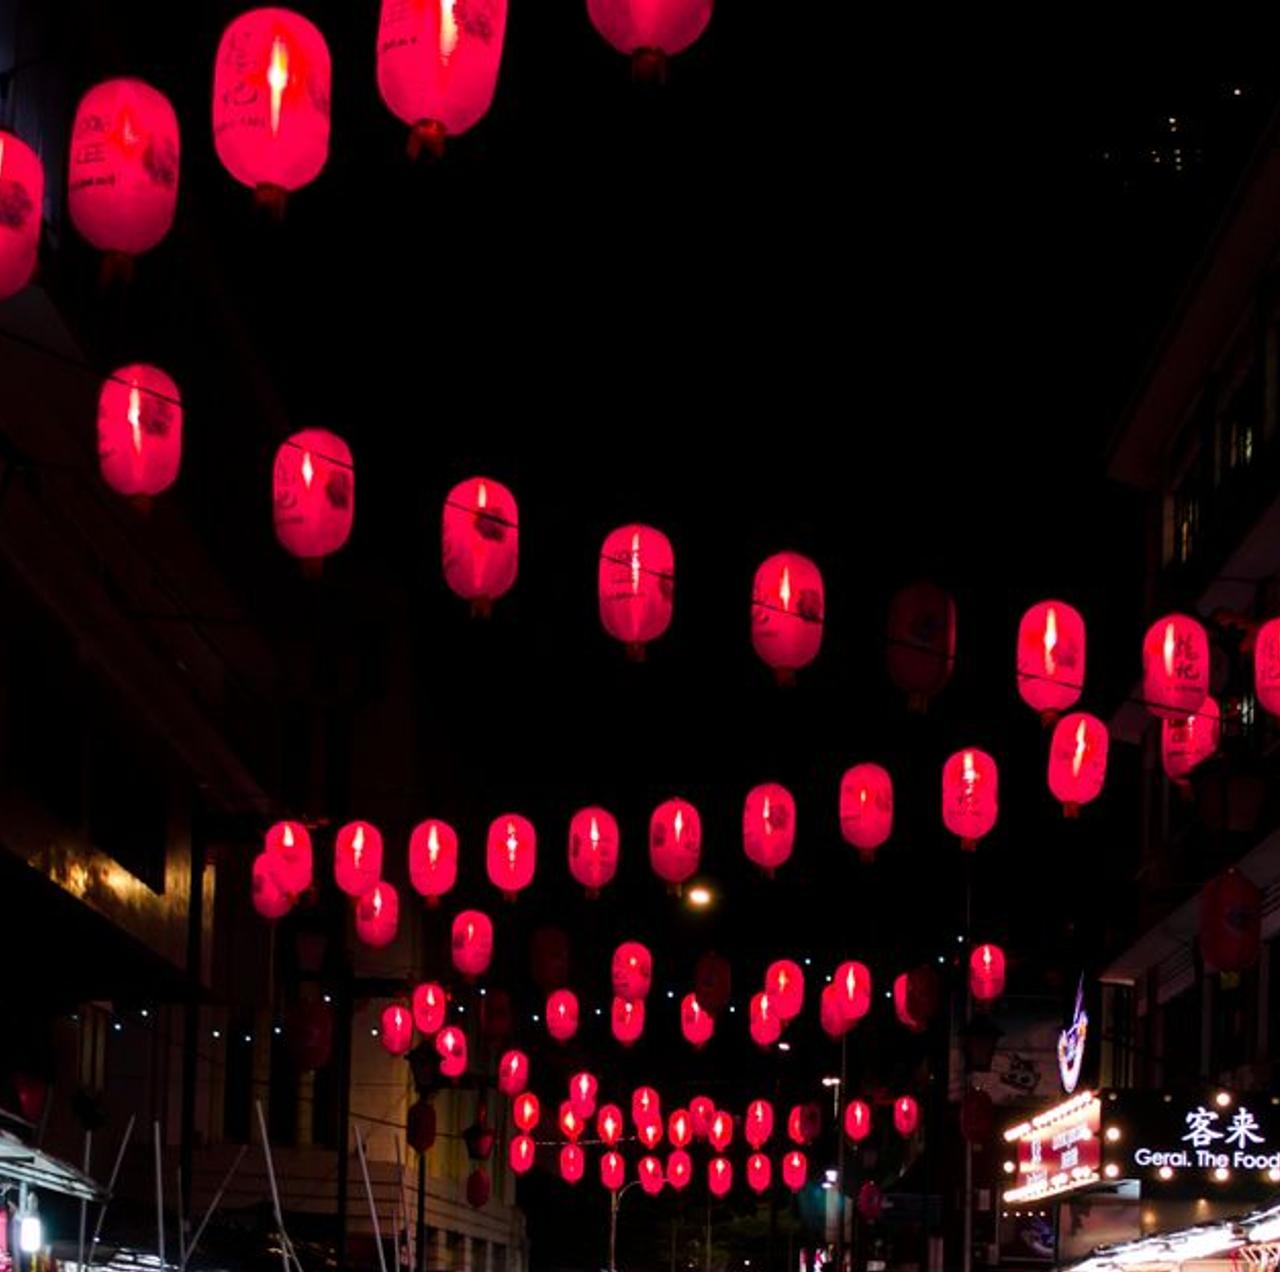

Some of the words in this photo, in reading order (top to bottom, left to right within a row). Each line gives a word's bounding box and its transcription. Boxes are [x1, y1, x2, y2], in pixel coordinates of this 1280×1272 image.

[1181, 1106, 1265, 1149] 客来
[1134, 1148, 1192, 1168] Gerai.
[1196, 1150, 1229, 1169] The
